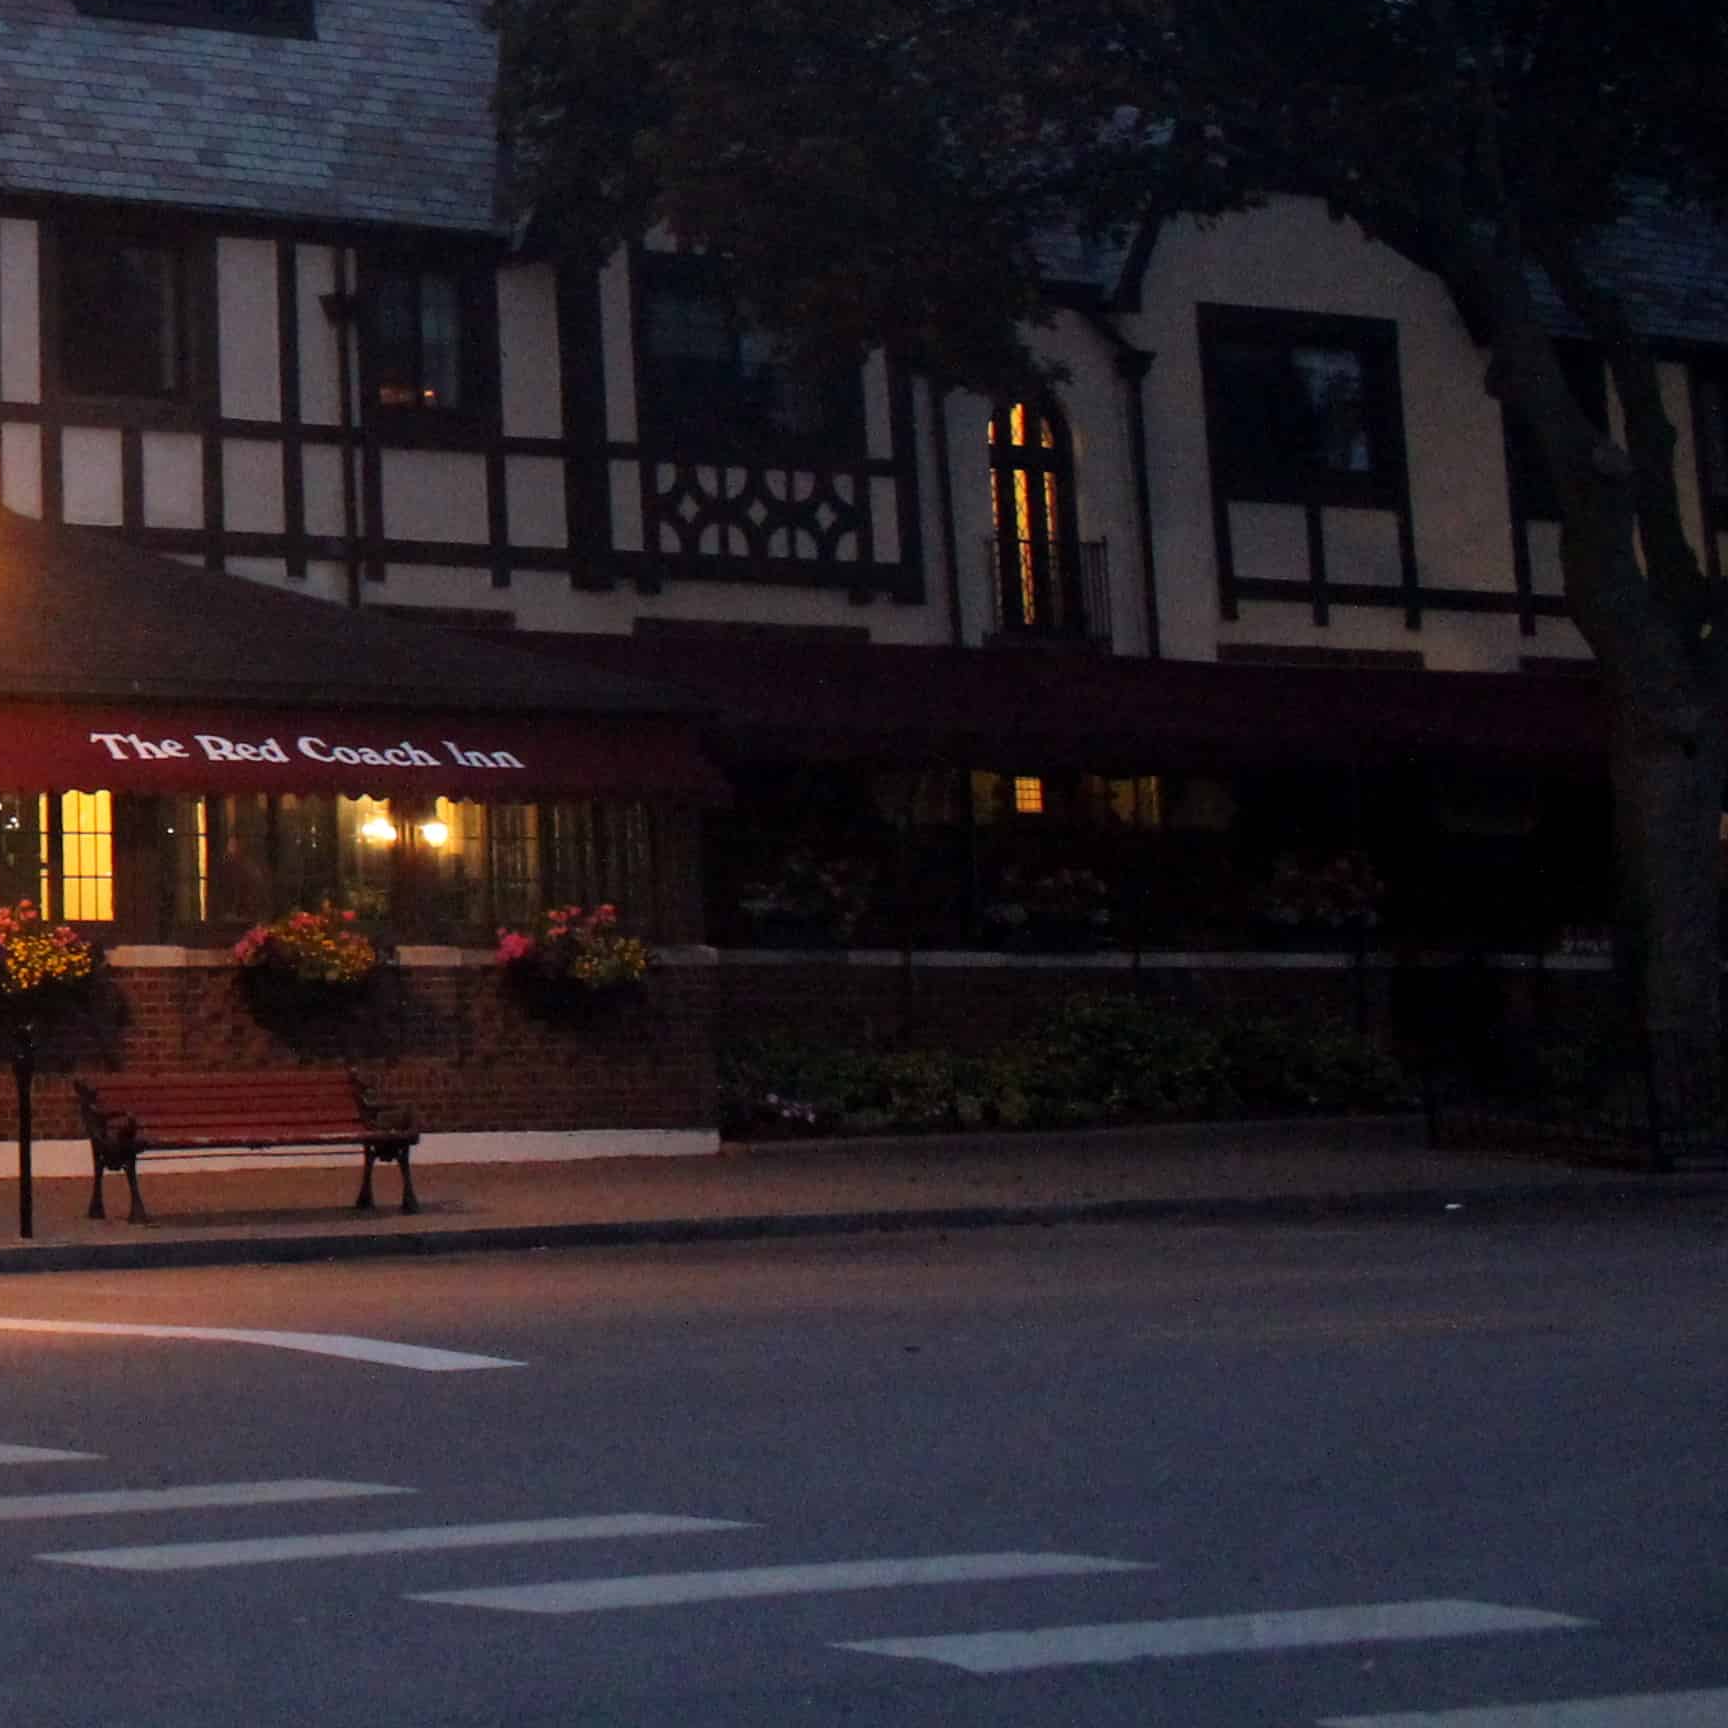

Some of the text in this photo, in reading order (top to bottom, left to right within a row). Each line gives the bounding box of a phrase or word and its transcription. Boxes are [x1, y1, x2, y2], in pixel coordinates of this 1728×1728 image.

[89, 732, 526, 769] The Red Coach Inn
